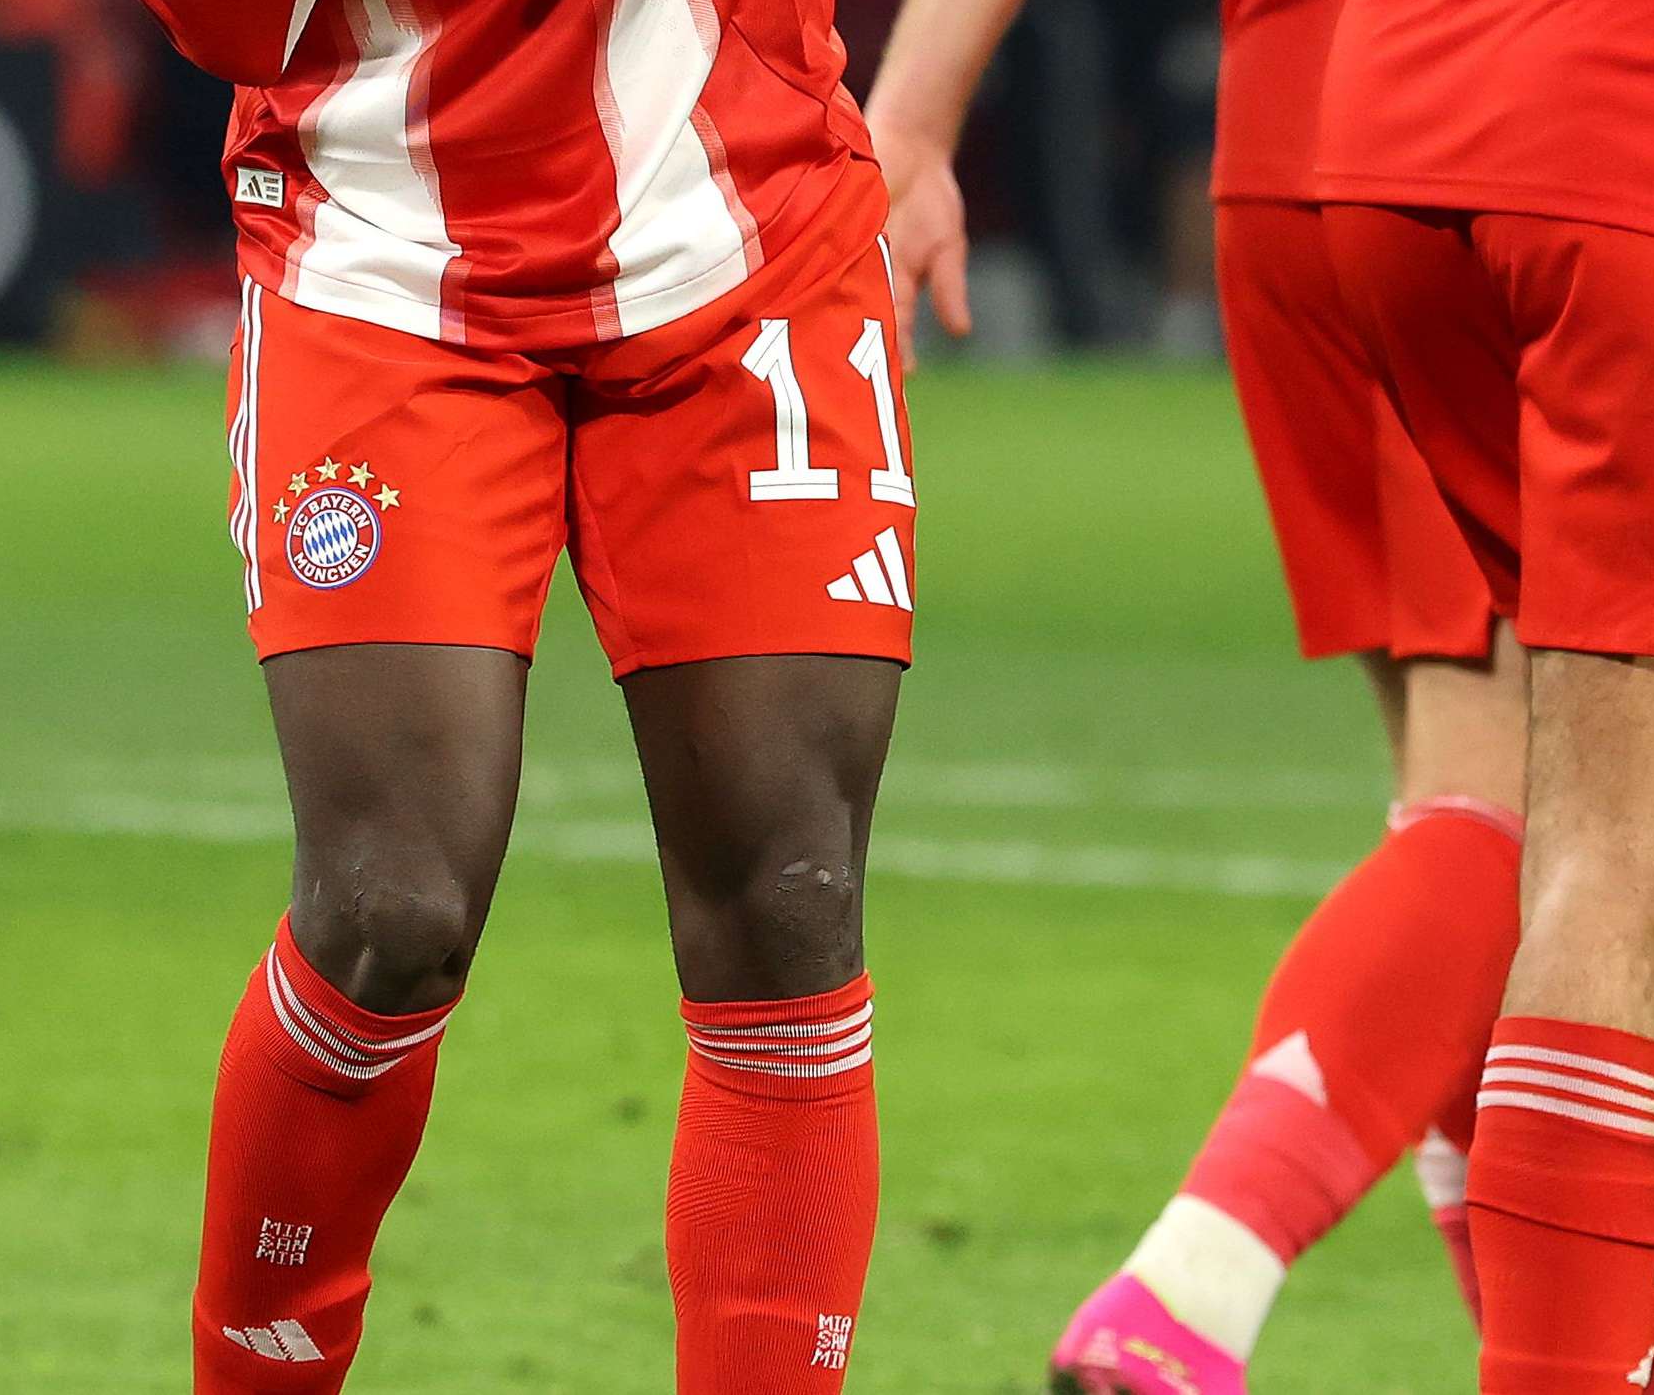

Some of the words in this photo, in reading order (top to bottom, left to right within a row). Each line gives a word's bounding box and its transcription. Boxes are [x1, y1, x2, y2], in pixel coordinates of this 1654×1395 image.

[740, 318, 916, 508] 11
[292, 513, 309, 536] FC
[308, 495, 371, 529] BAYERN
[261, 1217, 312, 1238] MIA
[259, 1233, 308, 1252] SAN
[256, 1245, 304, 1266] MIA
[818, 1313, 852, 1333] MIA
